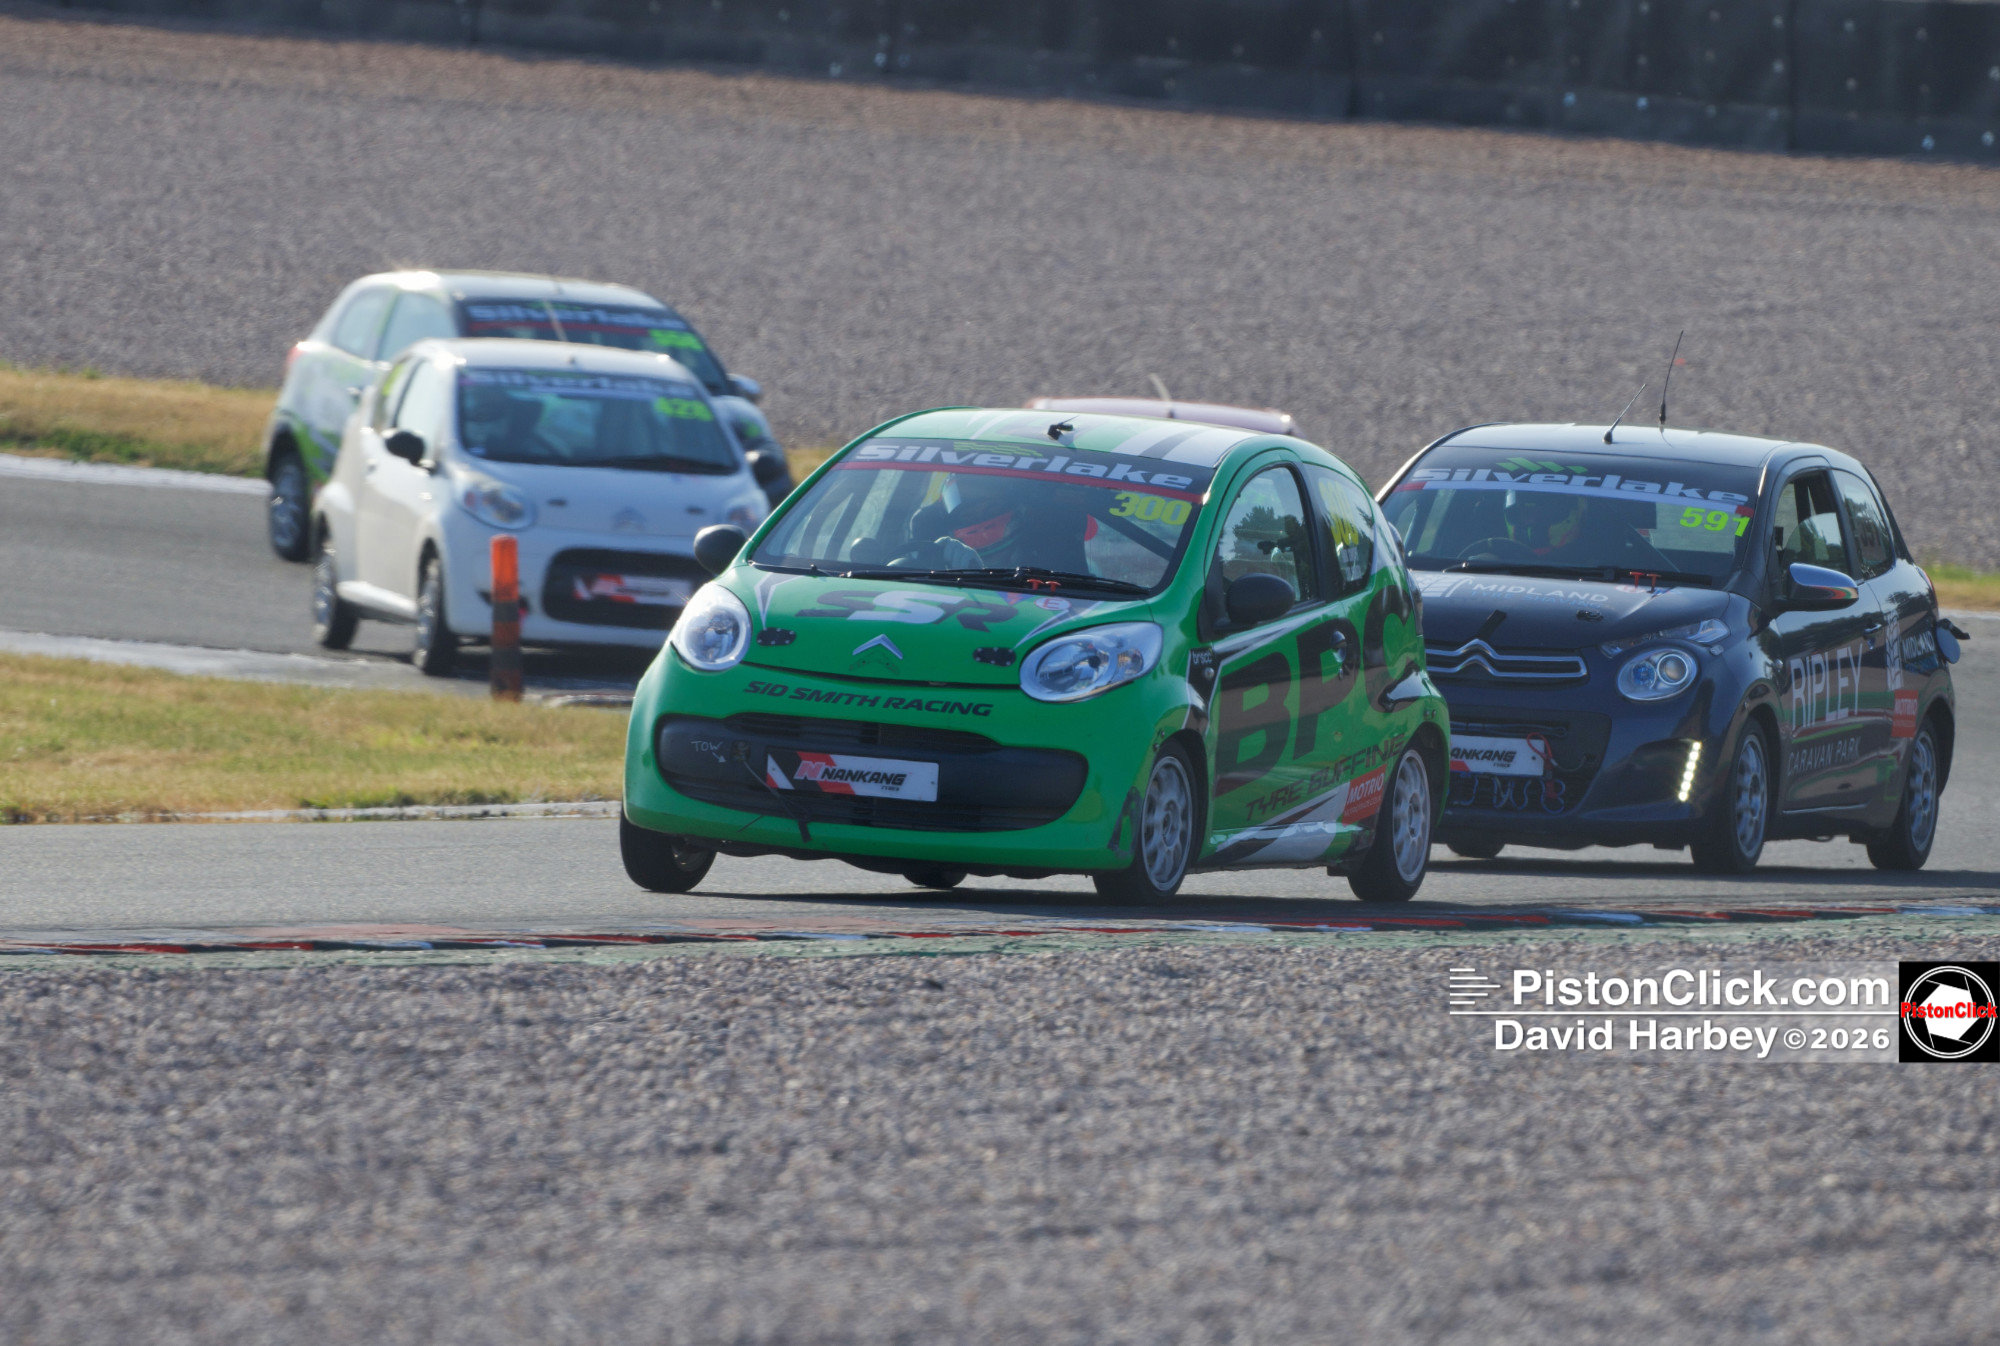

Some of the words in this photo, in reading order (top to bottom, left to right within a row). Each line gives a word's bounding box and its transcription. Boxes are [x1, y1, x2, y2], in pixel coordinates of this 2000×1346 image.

[854, 445, 1194, 489] Silverlake
[1411, 467, 1749, 503] Silverlake
[1109, 492, 1193, 526] 300
[1679, 507, 1751, 537] 591
[1474, 583, 1608, 602] MIDLAND
[795, 590, 1018, 633] SSR
[1903, 630, 1935, 658] MIDLAND
[743, 681, 789, 697] SID
[789, 687, 883, 707] SMITH
[882, 697, 994, 718] RACING
[1790, 643, 1863, 732] RIPLEY
[691, 740, 723, 752] TOW
[1450, 748, 1517, 763] ANKANG
[1787, 744, 1832, 777] CARAVAN
[1834, 736, 1861, 763] PARK
[820, 765, 907, 786] NANKANG
[1350, 772, 1386, 802] MOTRIO
[1246, 778, 1304, 821] TYRE
